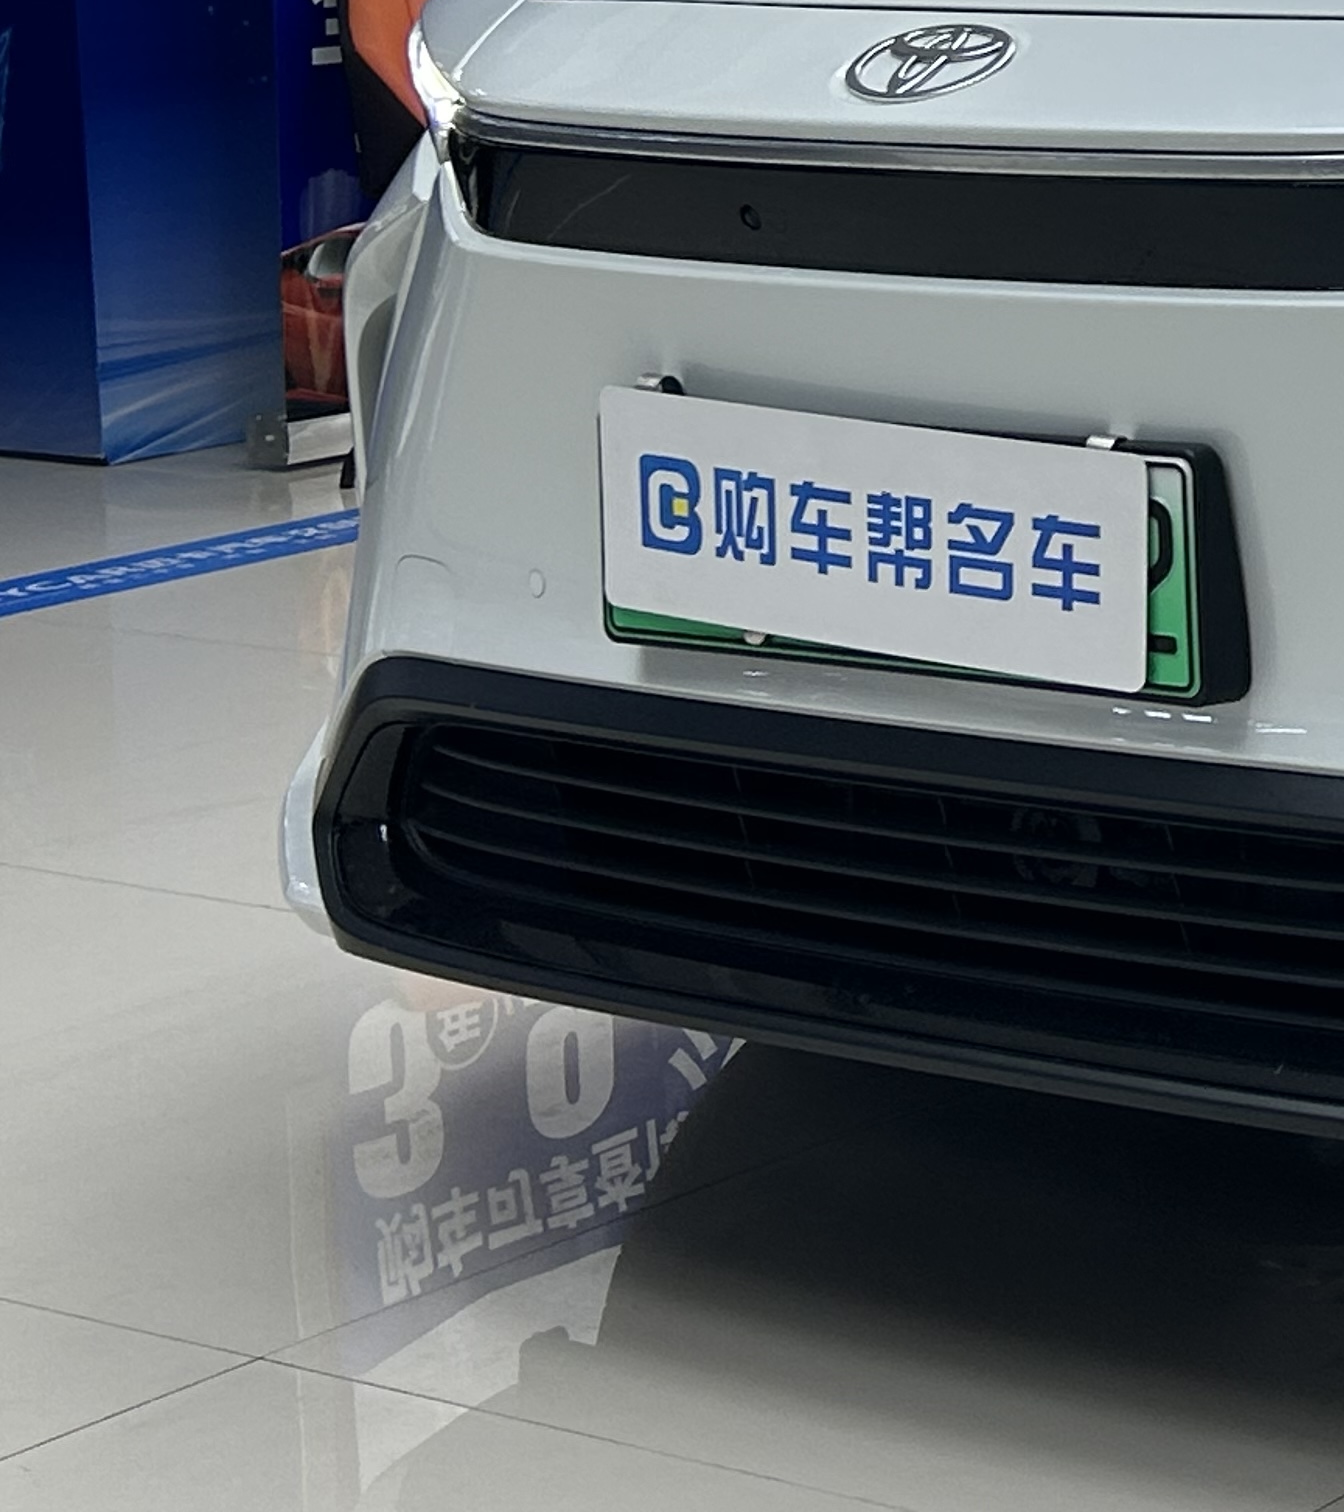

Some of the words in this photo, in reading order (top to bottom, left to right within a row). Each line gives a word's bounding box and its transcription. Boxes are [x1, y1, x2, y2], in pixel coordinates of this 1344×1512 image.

[712, 465, 1102, 613] 购车帮名车
